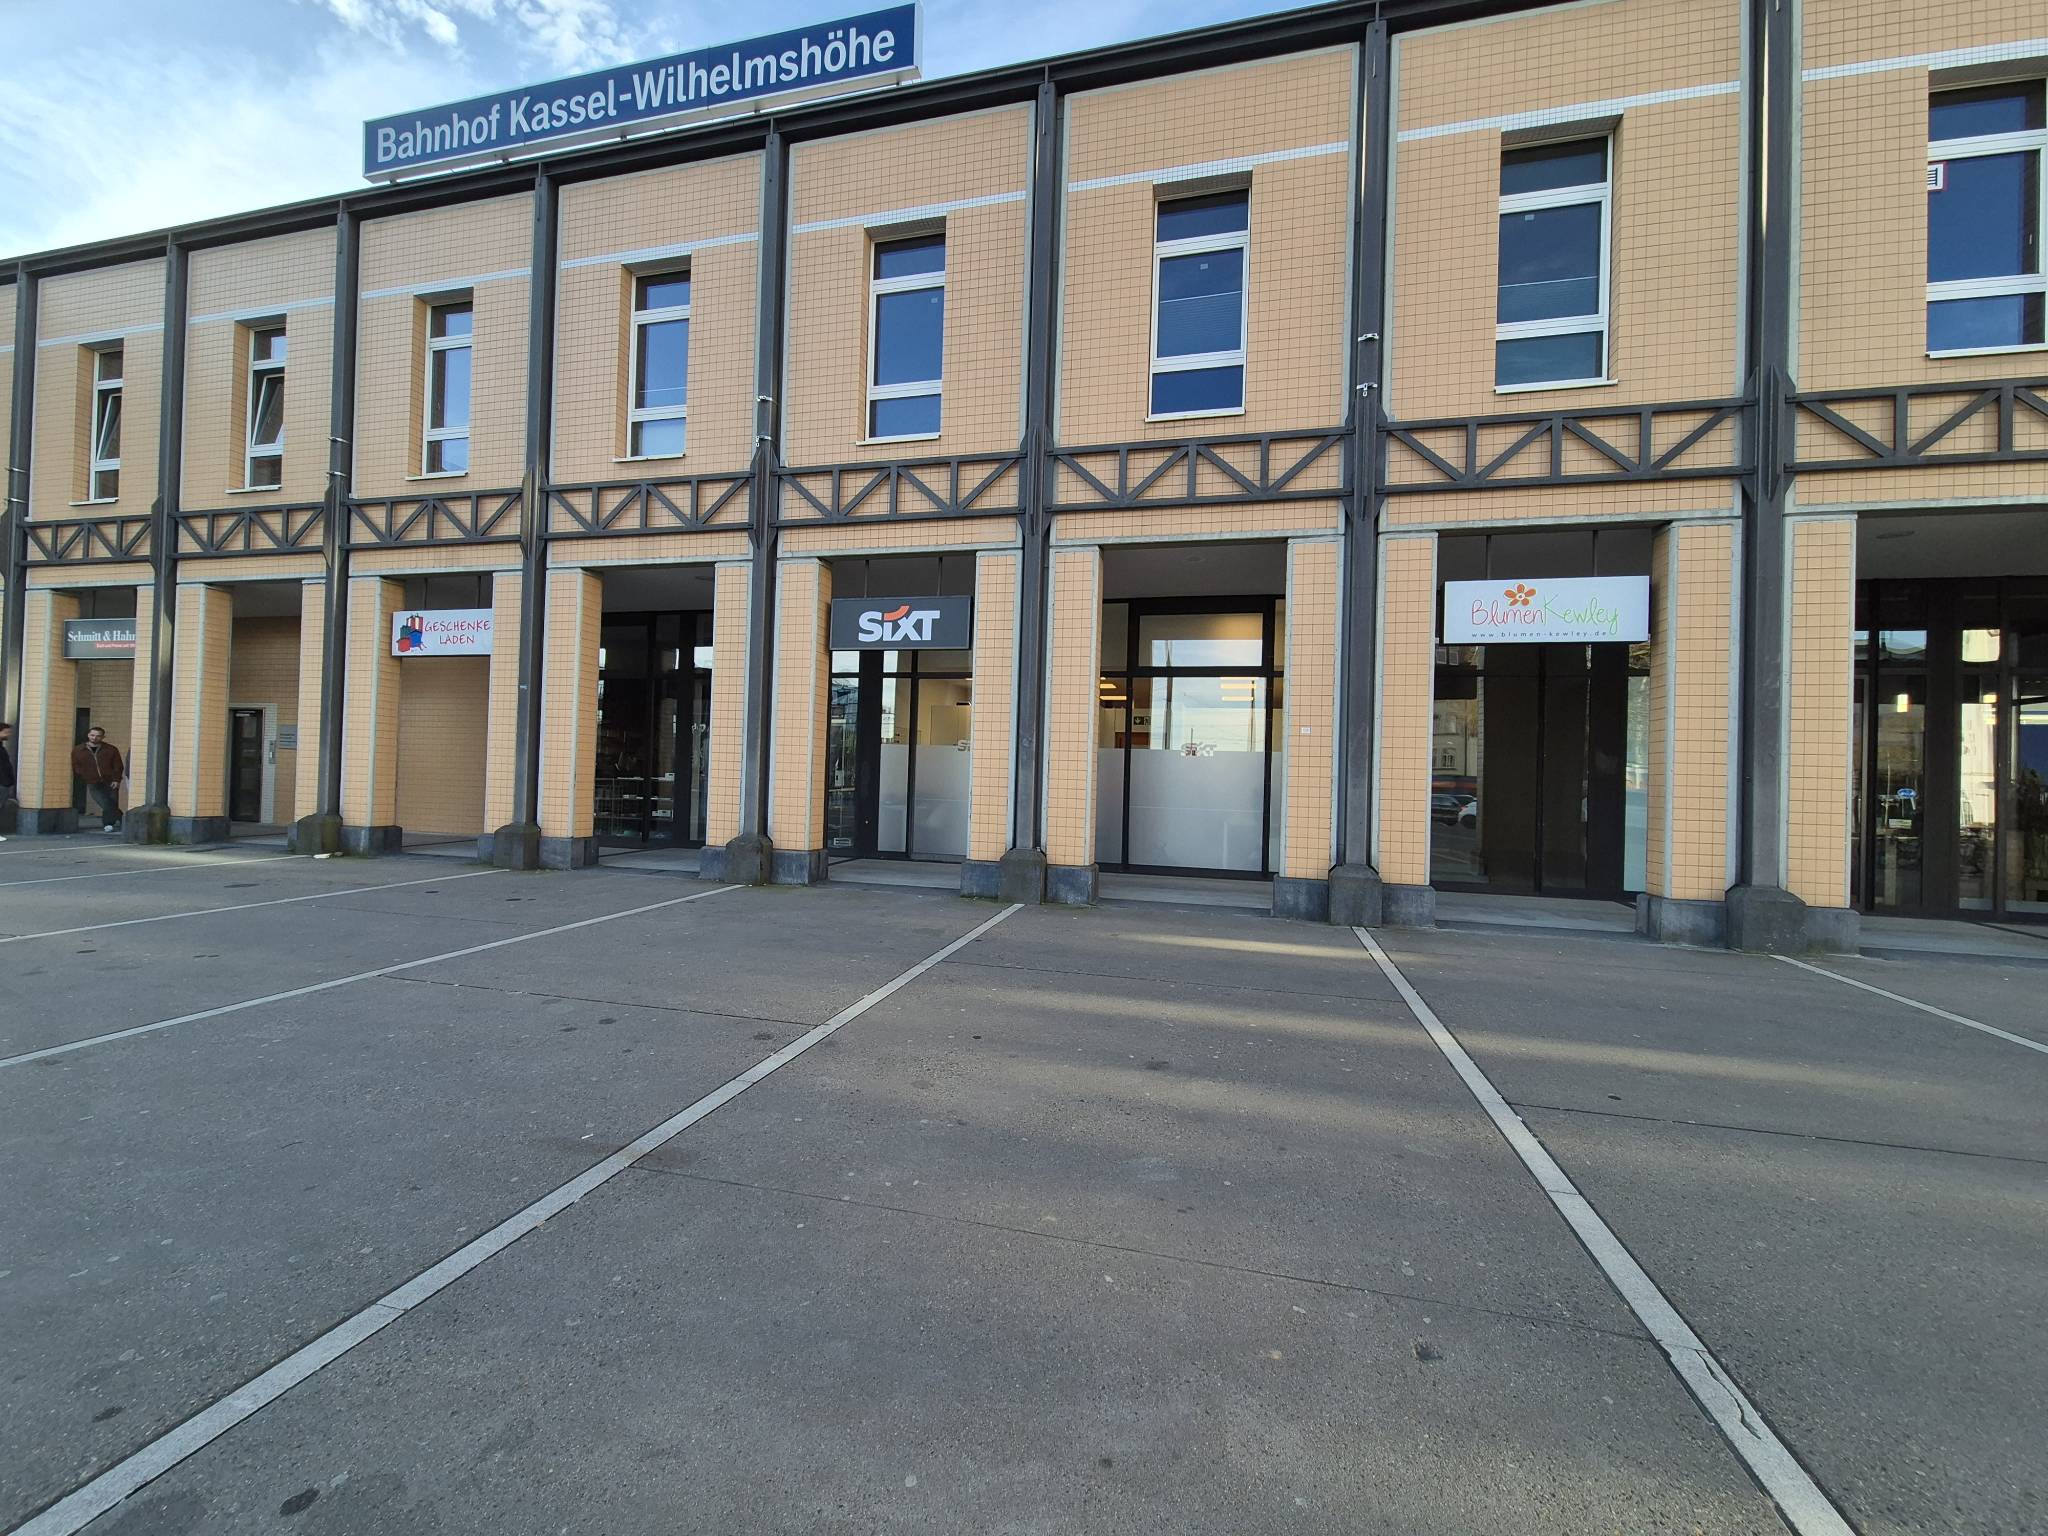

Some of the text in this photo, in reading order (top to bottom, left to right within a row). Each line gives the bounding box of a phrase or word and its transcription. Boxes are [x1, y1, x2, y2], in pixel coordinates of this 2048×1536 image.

[377, 27, 895, 163] Bahnhof Kassel-Wilhelmshöhe
[424, 619, 491, 632] GESCHENKE
[68, 630, 101, 641] Schmitt
[103, 630, 111, 641] &
[439, 634, 475, 645] LADEN
[1471, 630, 1607, 639] www.blumen-kewley.de
